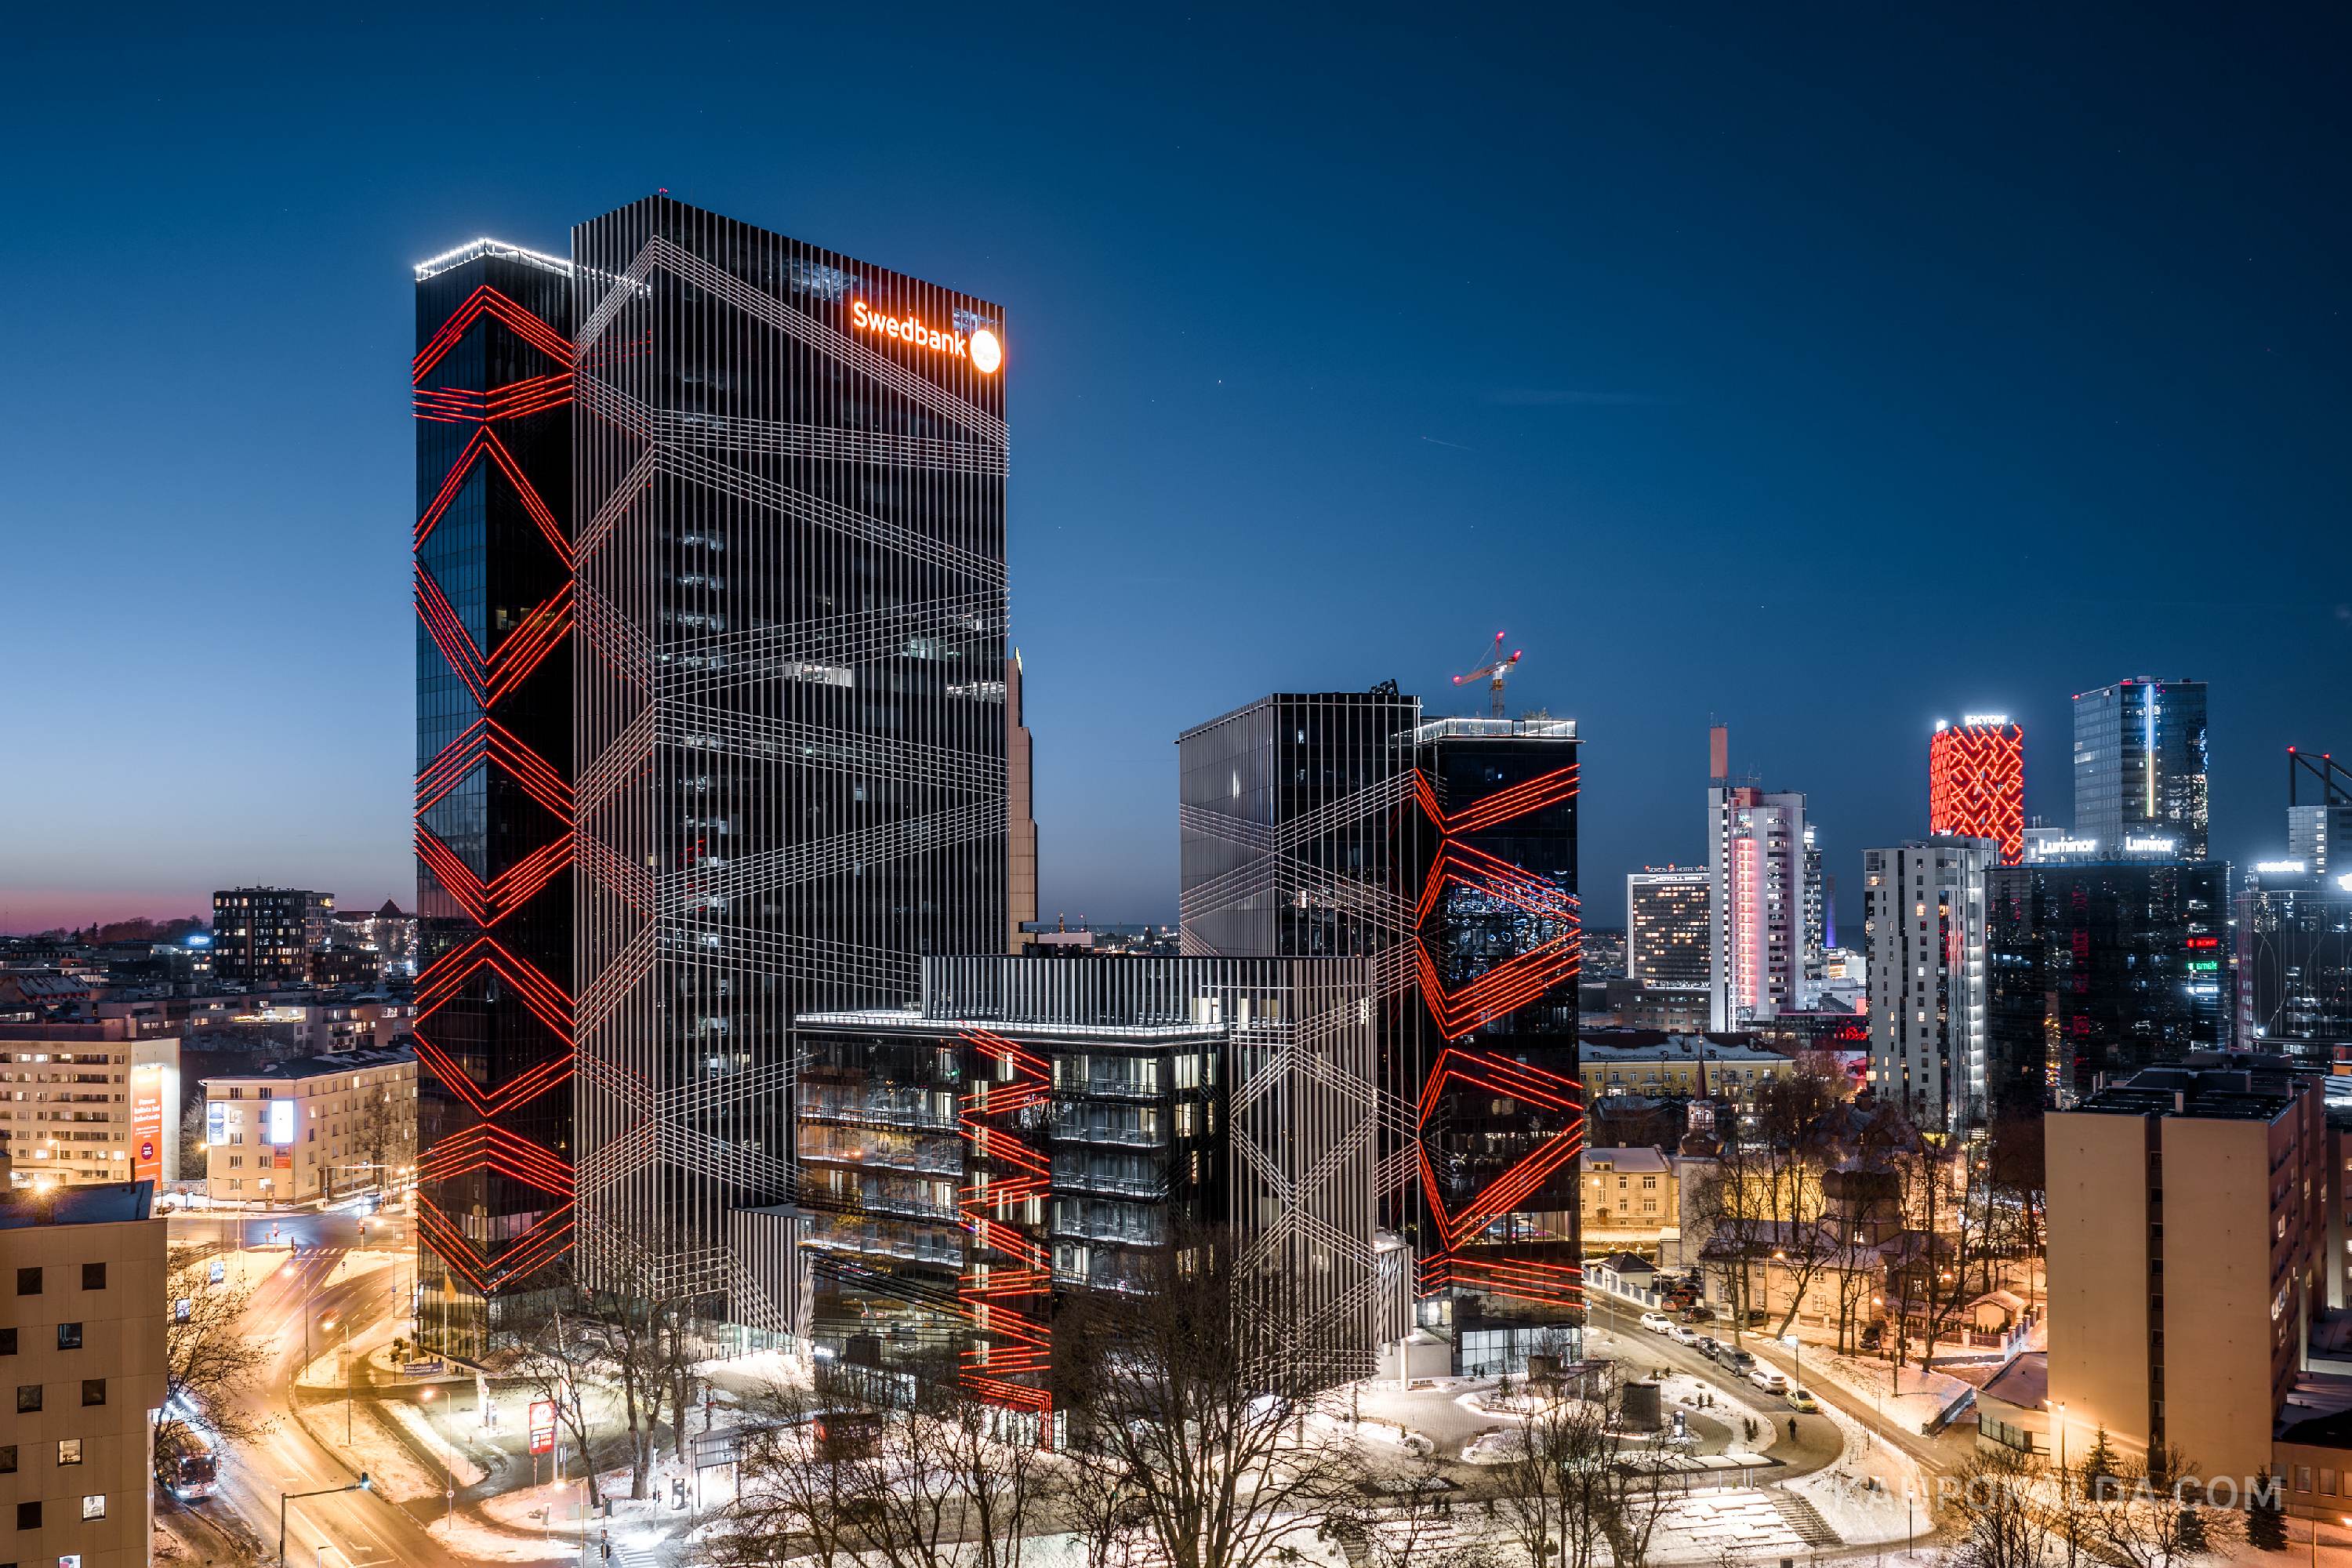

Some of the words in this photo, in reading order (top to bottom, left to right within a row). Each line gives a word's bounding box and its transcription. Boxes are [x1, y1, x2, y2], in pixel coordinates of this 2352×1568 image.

[853, 301, 967, 358] Swedbank
[2039, 837, 2096, 854] Luminor
[2125, 835, 2173, 852] Luminor
